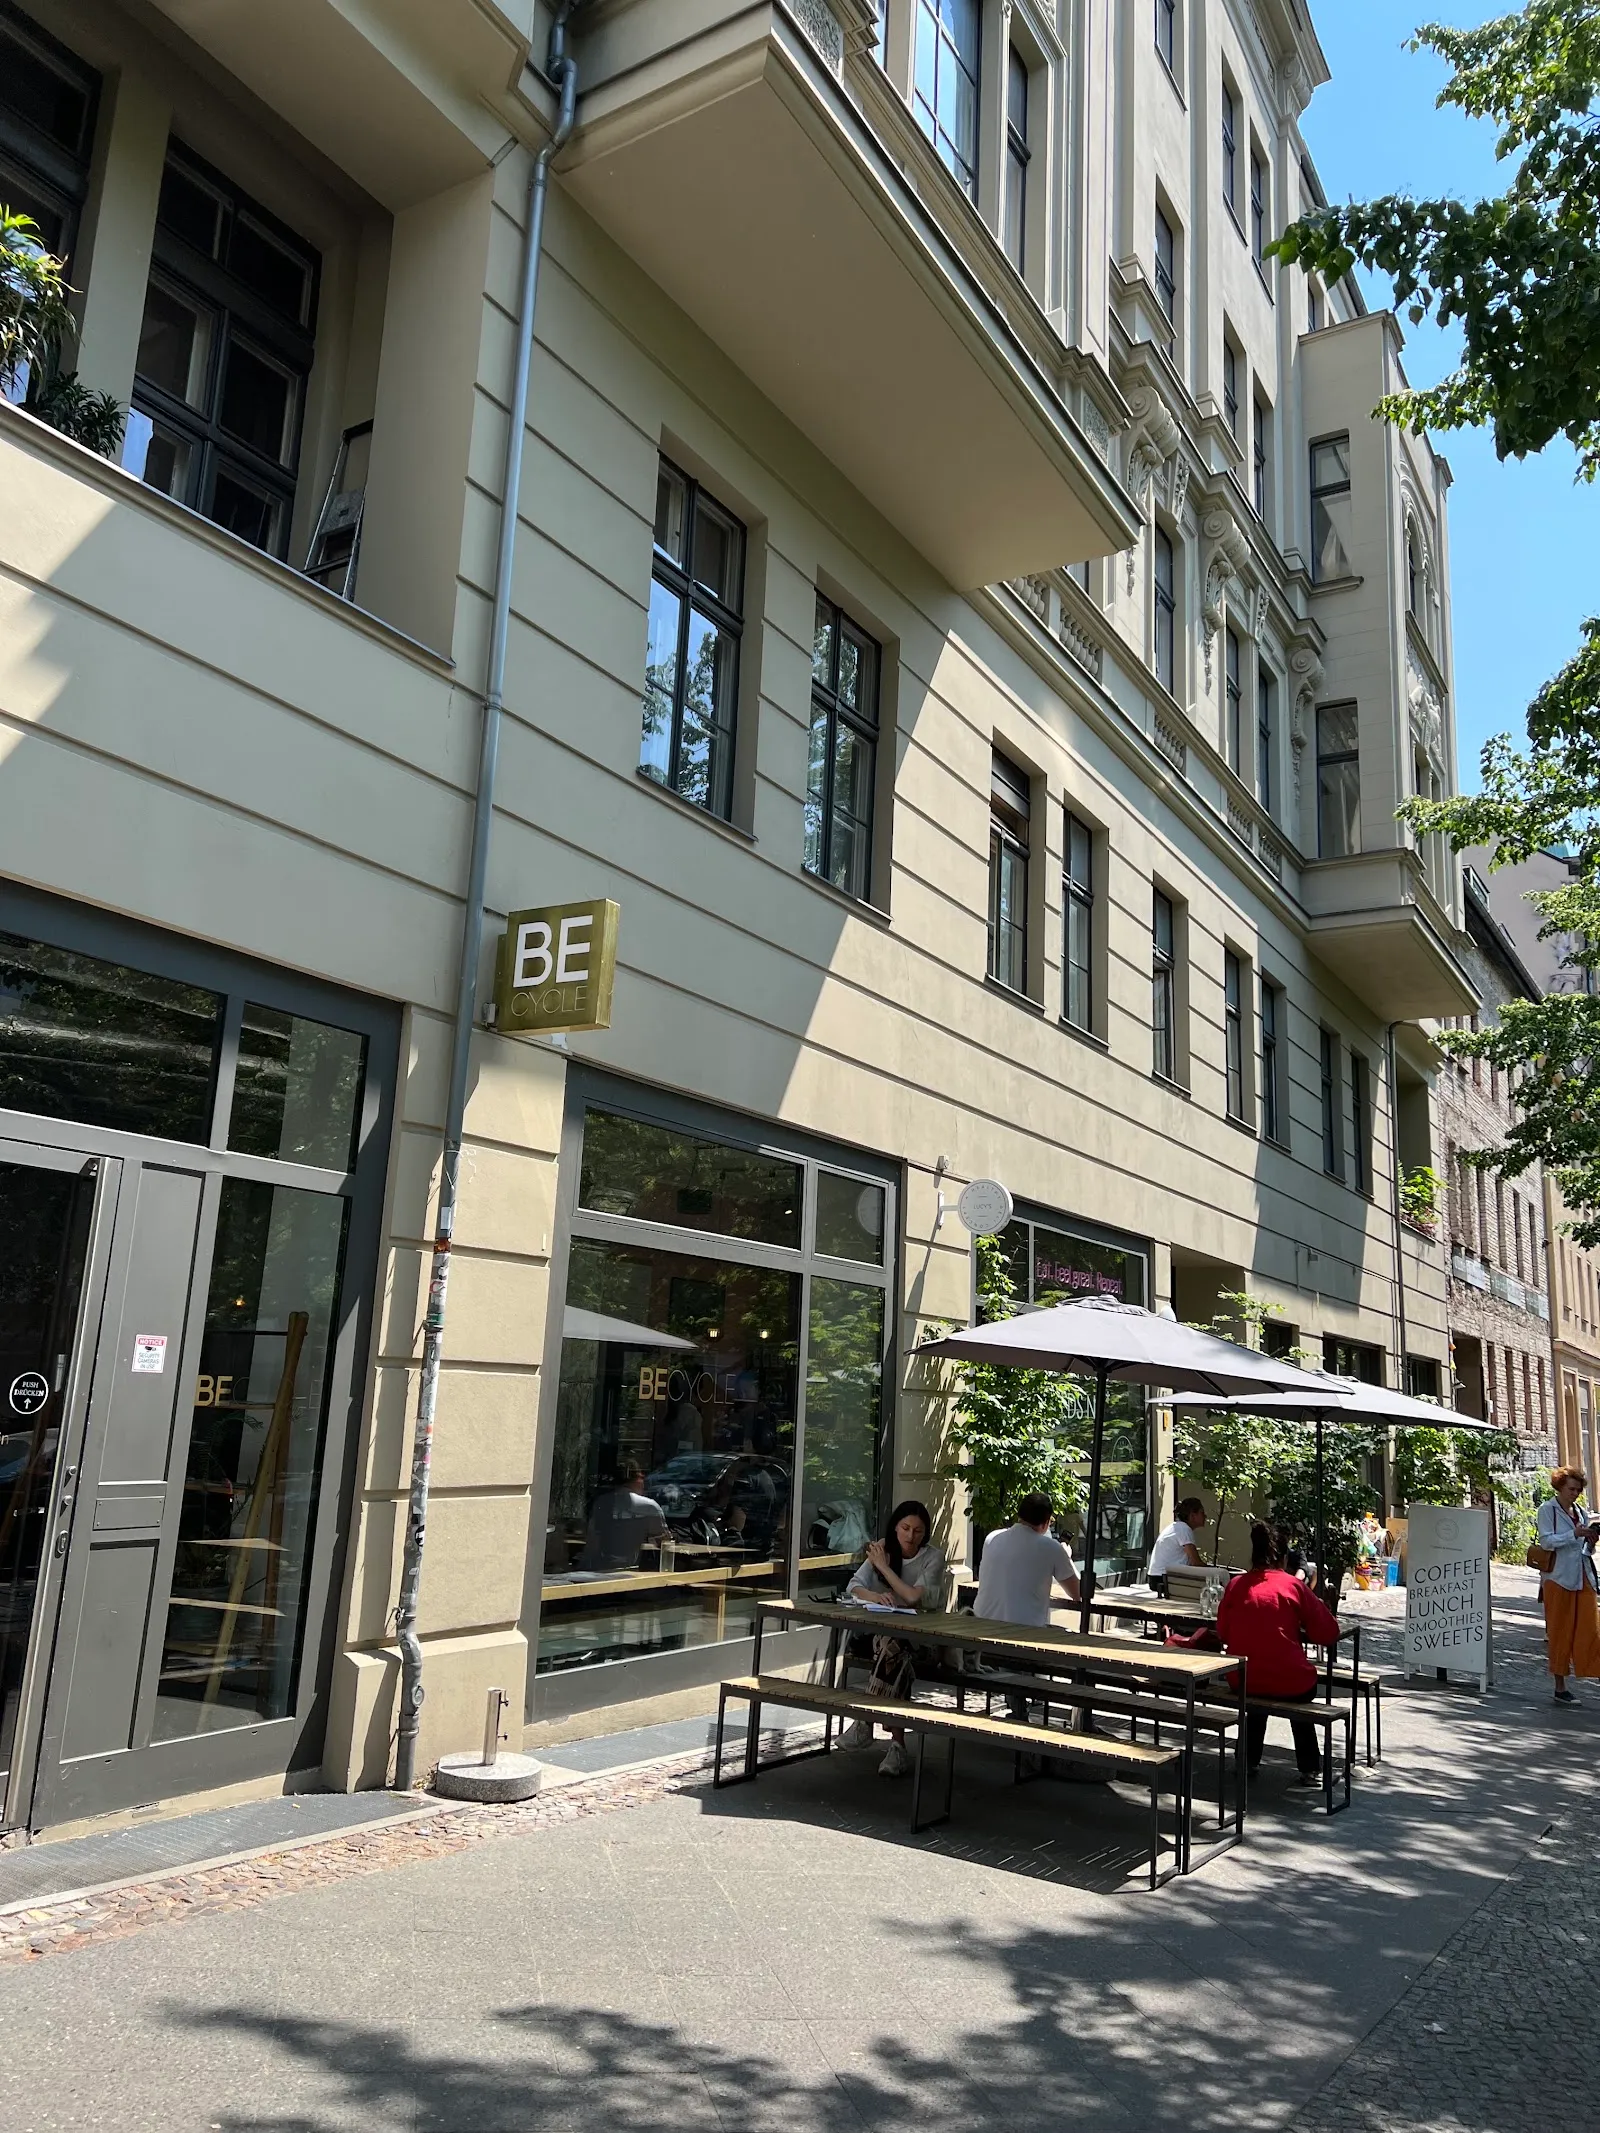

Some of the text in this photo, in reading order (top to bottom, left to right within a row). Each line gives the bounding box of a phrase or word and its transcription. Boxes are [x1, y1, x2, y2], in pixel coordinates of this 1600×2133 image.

[513, 915, 593, 988] BE
[511, 985, 588, 1016] CYCLE
[139, 1338, 163, 1346] NOTICE
[14, 1388, 44, 1397] DRÜCKEN
[22, 1381, 39, 1389] PUSH
[638, 1366, 736, 1405] BECYCLE
[1414, 1557, 1482, 1584] COFFEE
[1409, 1579, 1476, 1600] BREAKFAST
[1409, 1594, 1473, 1619] LUNCH
[1408, 1611, 1483, 1635] SMOOTHIES
[1413, 1626, 1483, 1652] SWEETS
